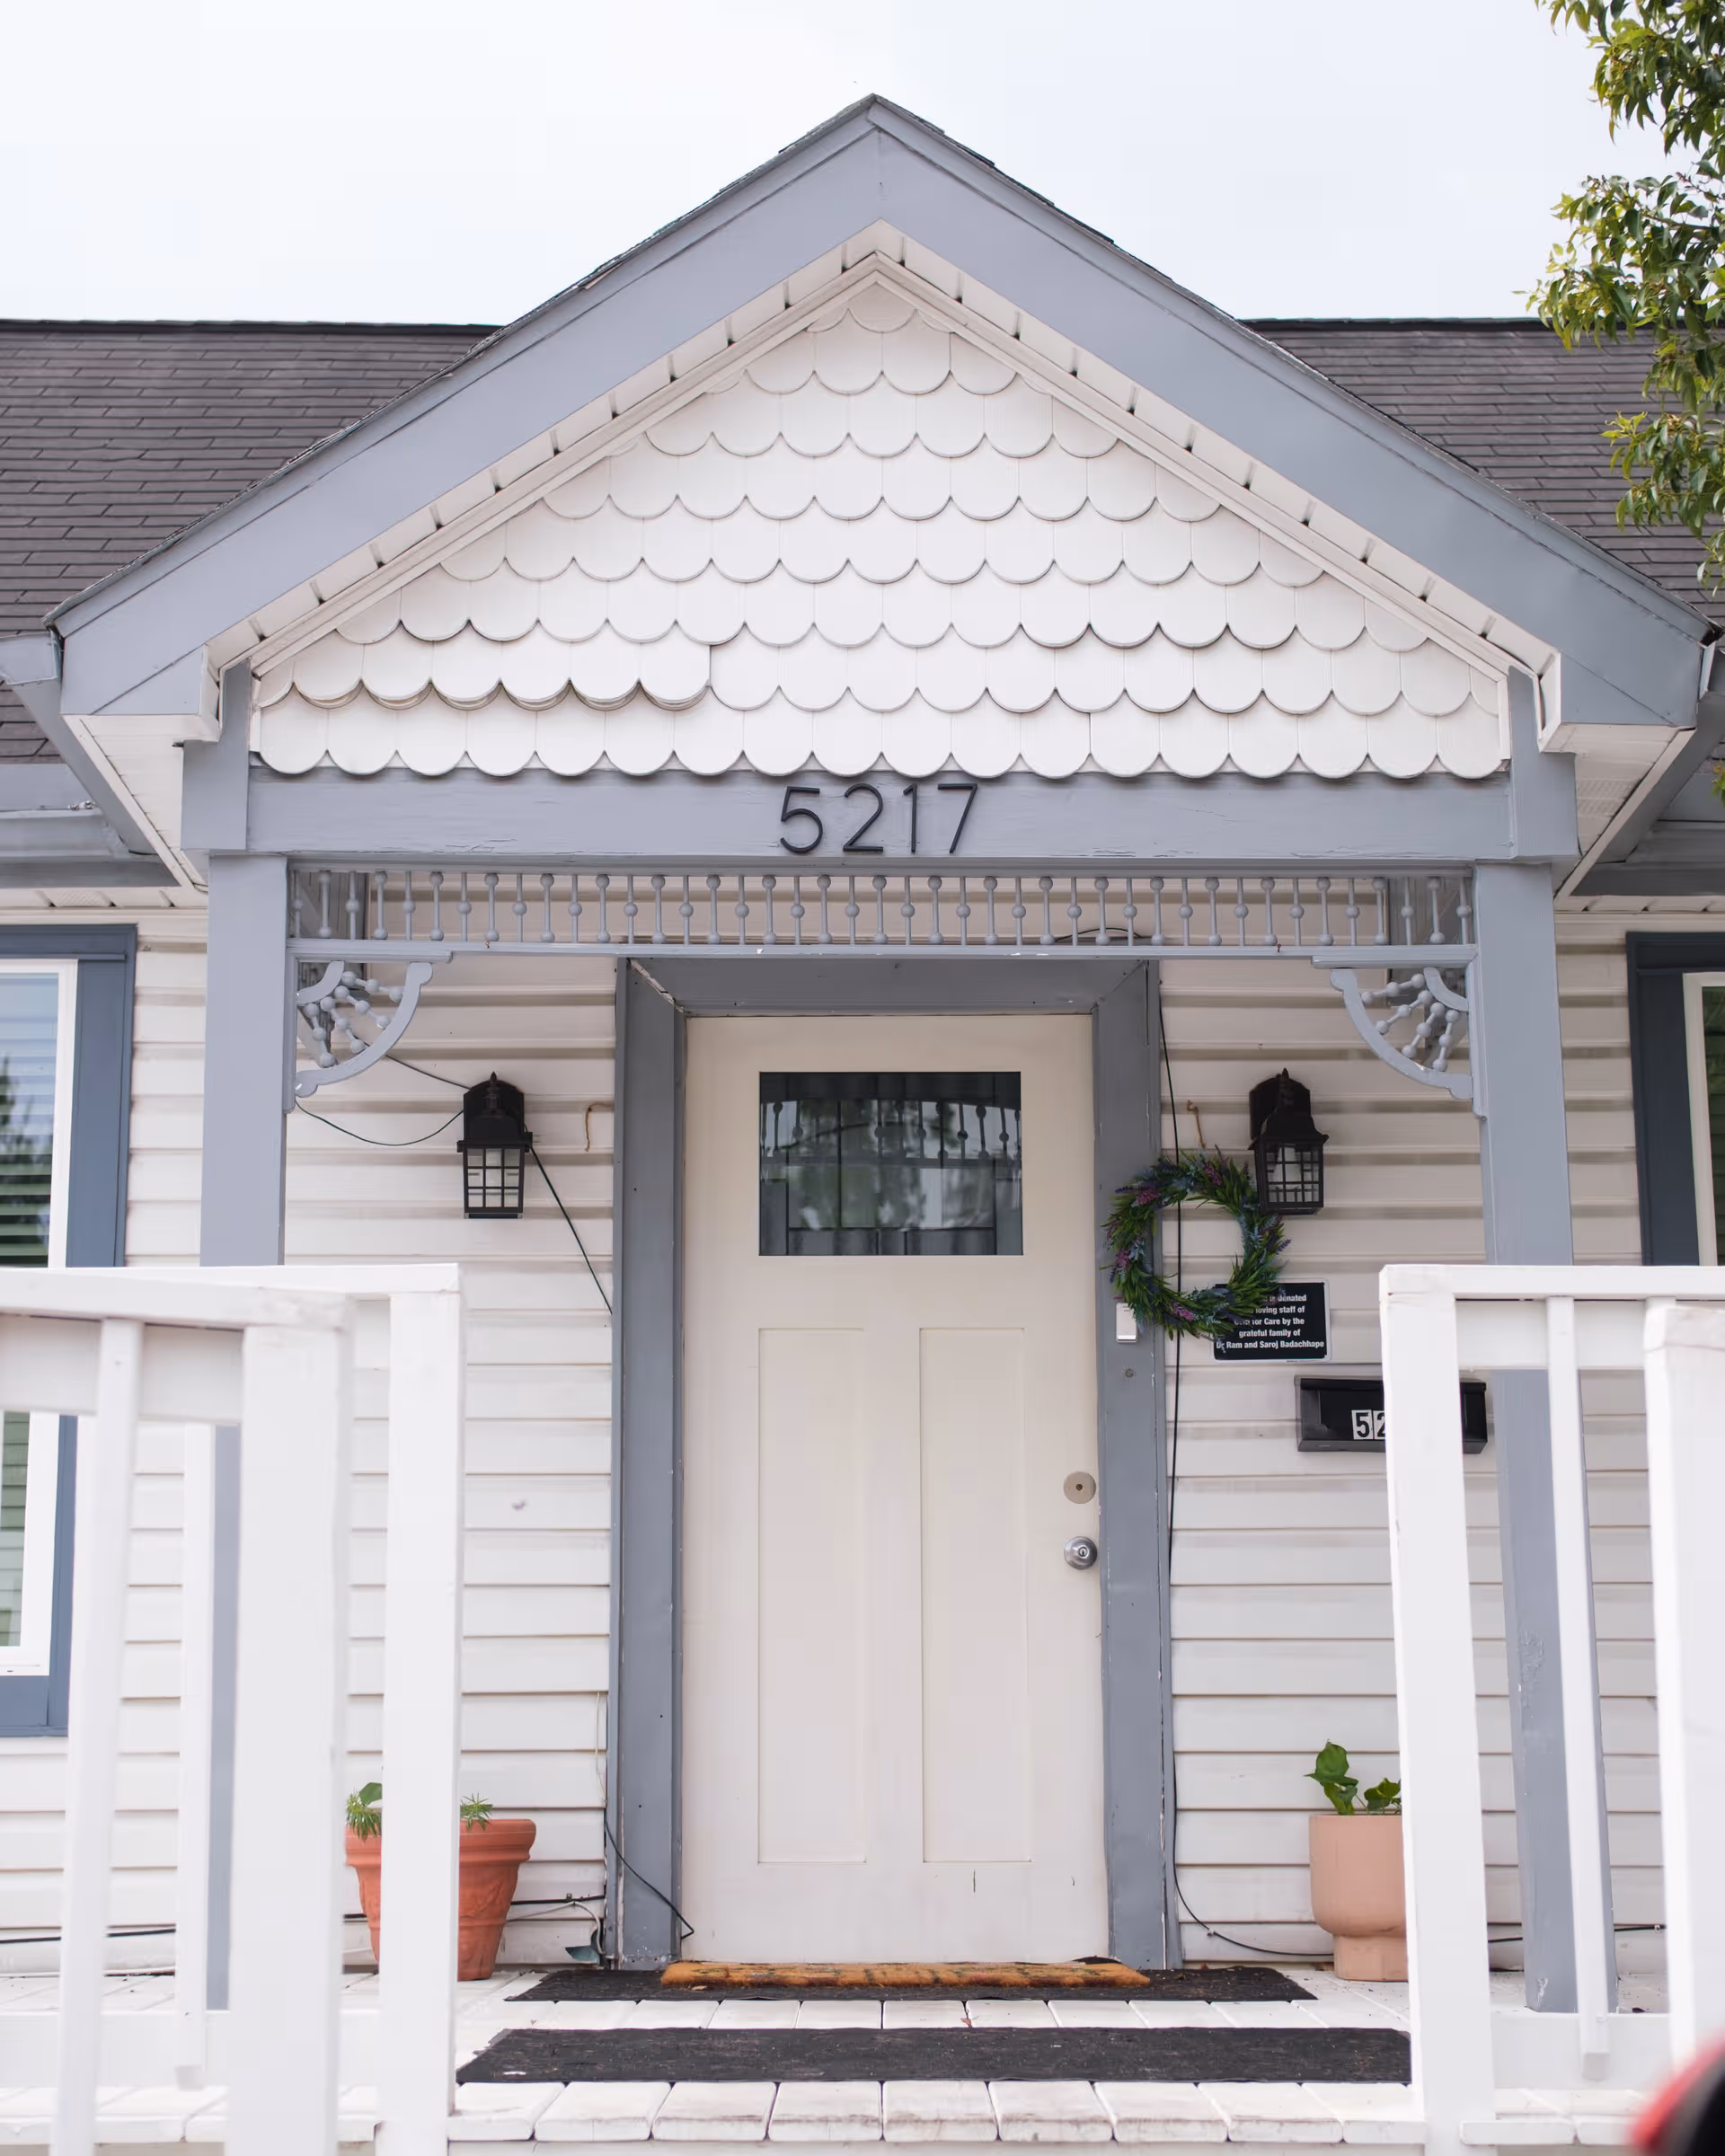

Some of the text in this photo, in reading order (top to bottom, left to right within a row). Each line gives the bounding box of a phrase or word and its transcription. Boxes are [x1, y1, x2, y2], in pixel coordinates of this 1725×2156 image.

[780, 782, 978, 854] 5217
[1278, 1294, 1307, 1302] donated
[1255, 1306, 1278, 1315] loving
[1278, 1305, 1296, 1313] staff
[1297, 1305, 1305, 1313] of
[1263, 1317, 1281, 1325] Care
[1282, 1317, 1292, 1327] by
[1292, 1317, 1305, 1325] the
[1239, 1329, 1301, 1339] grateful family of
[1216, 1341, 1225, 1349] Dr
[1243, 1340, 1258, 1348] and
[1259, 1340, 1278, 1350] Saroj
[1279, 1340, 1324, 1349] Badachhape
[1355, 1412, 1385, 1438] 52
